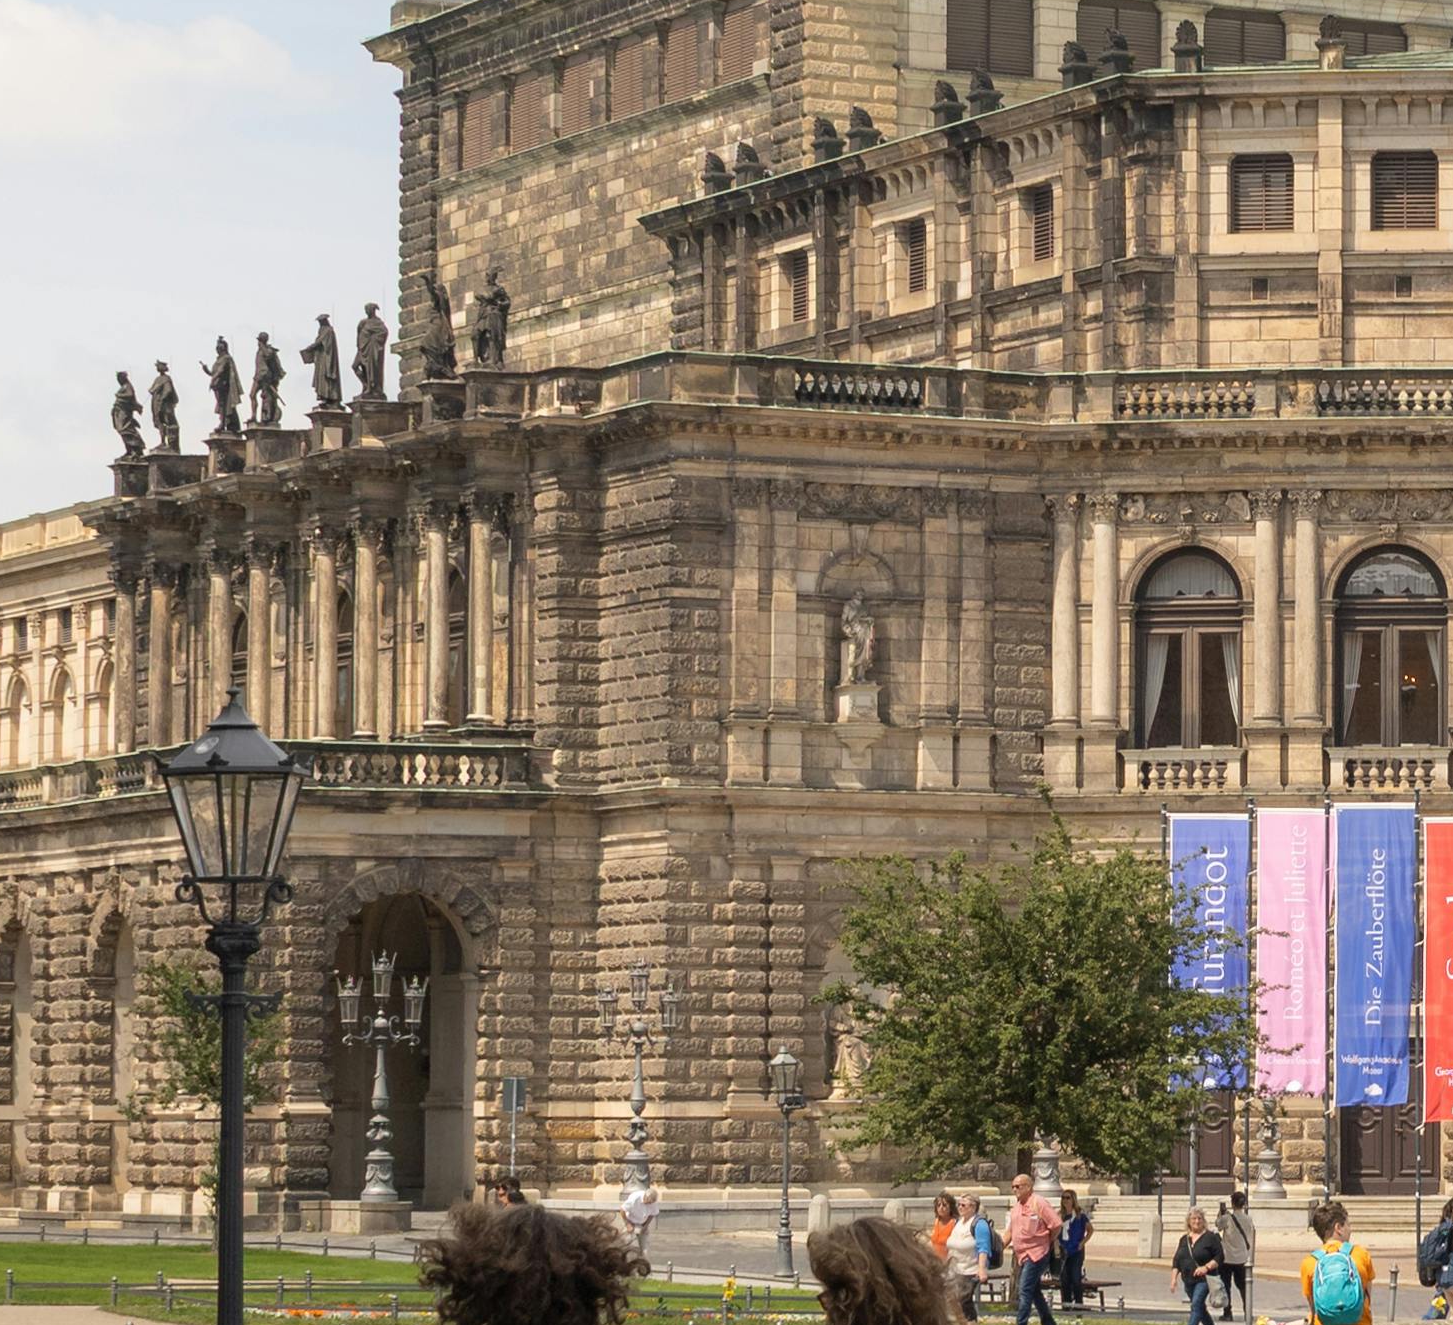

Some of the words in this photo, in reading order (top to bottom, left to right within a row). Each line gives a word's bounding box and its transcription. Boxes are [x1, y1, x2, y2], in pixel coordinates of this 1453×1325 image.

[1283, 824, 1309, 904] Juliette
[1288, 910, 1305, 932] et
[1364, 848, 1386, 978] Zauberflöte
[1282, 938, 1305, 1021] Roméo
[1364, 986, 1383, 1026] Die
